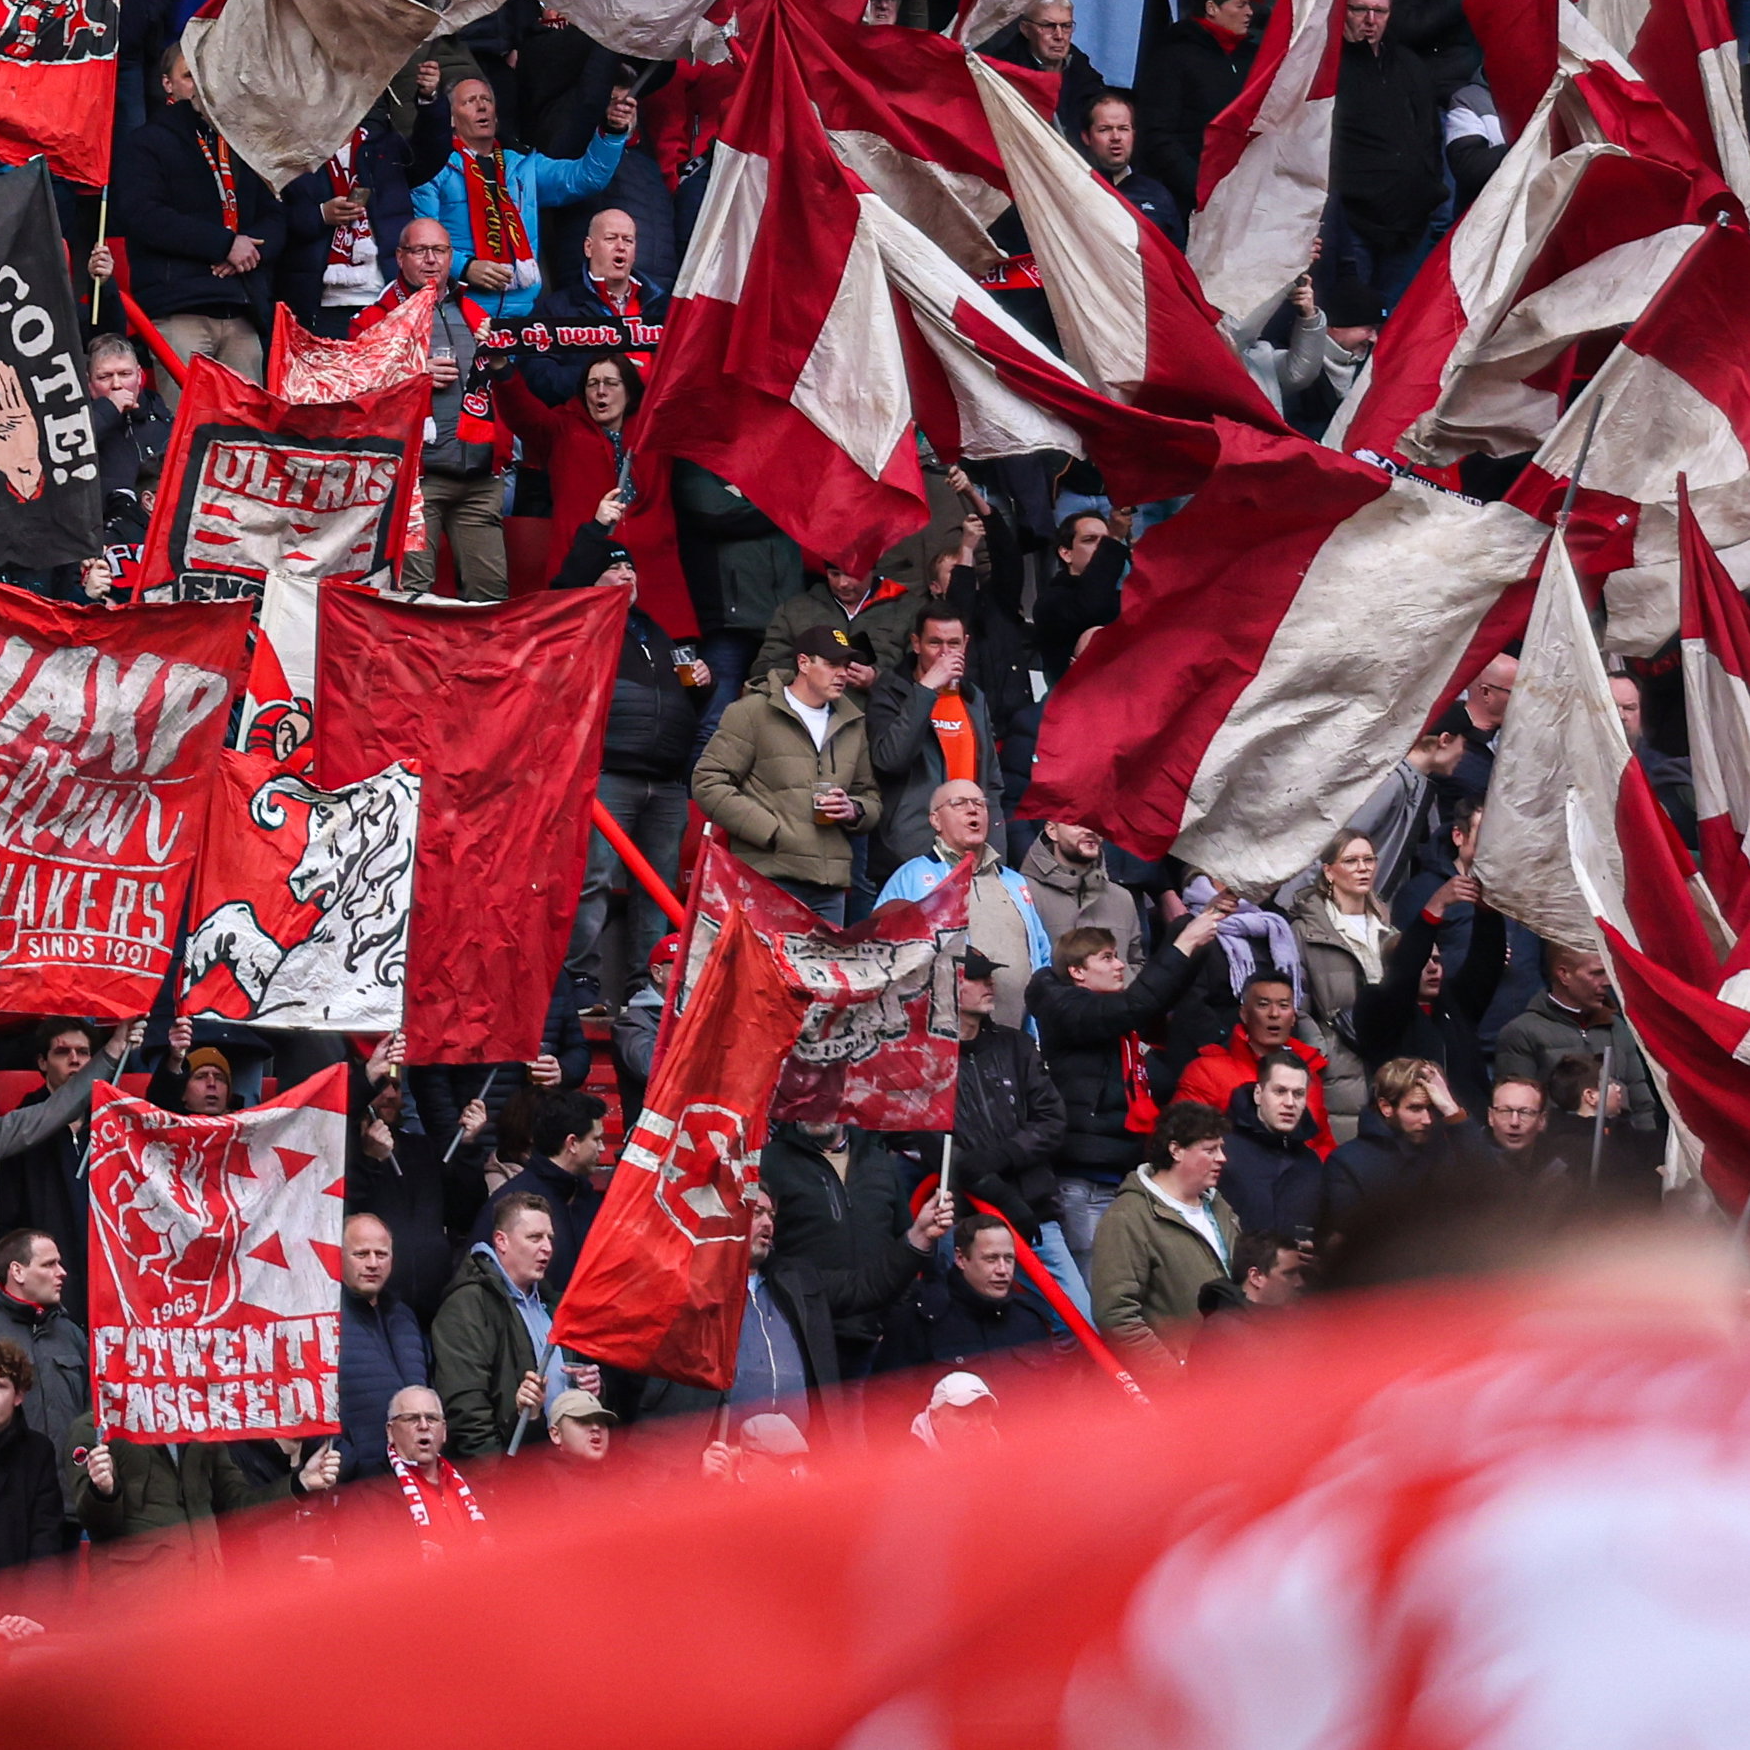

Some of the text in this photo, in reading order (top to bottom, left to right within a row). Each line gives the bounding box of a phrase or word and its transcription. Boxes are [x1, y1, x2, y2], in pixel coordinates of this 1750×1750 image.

[211, 441, 401, 514] ULTRAS
[27, 935, 153, 970] SINDS 1991
[150, 1291, 198, 1326] 1965
